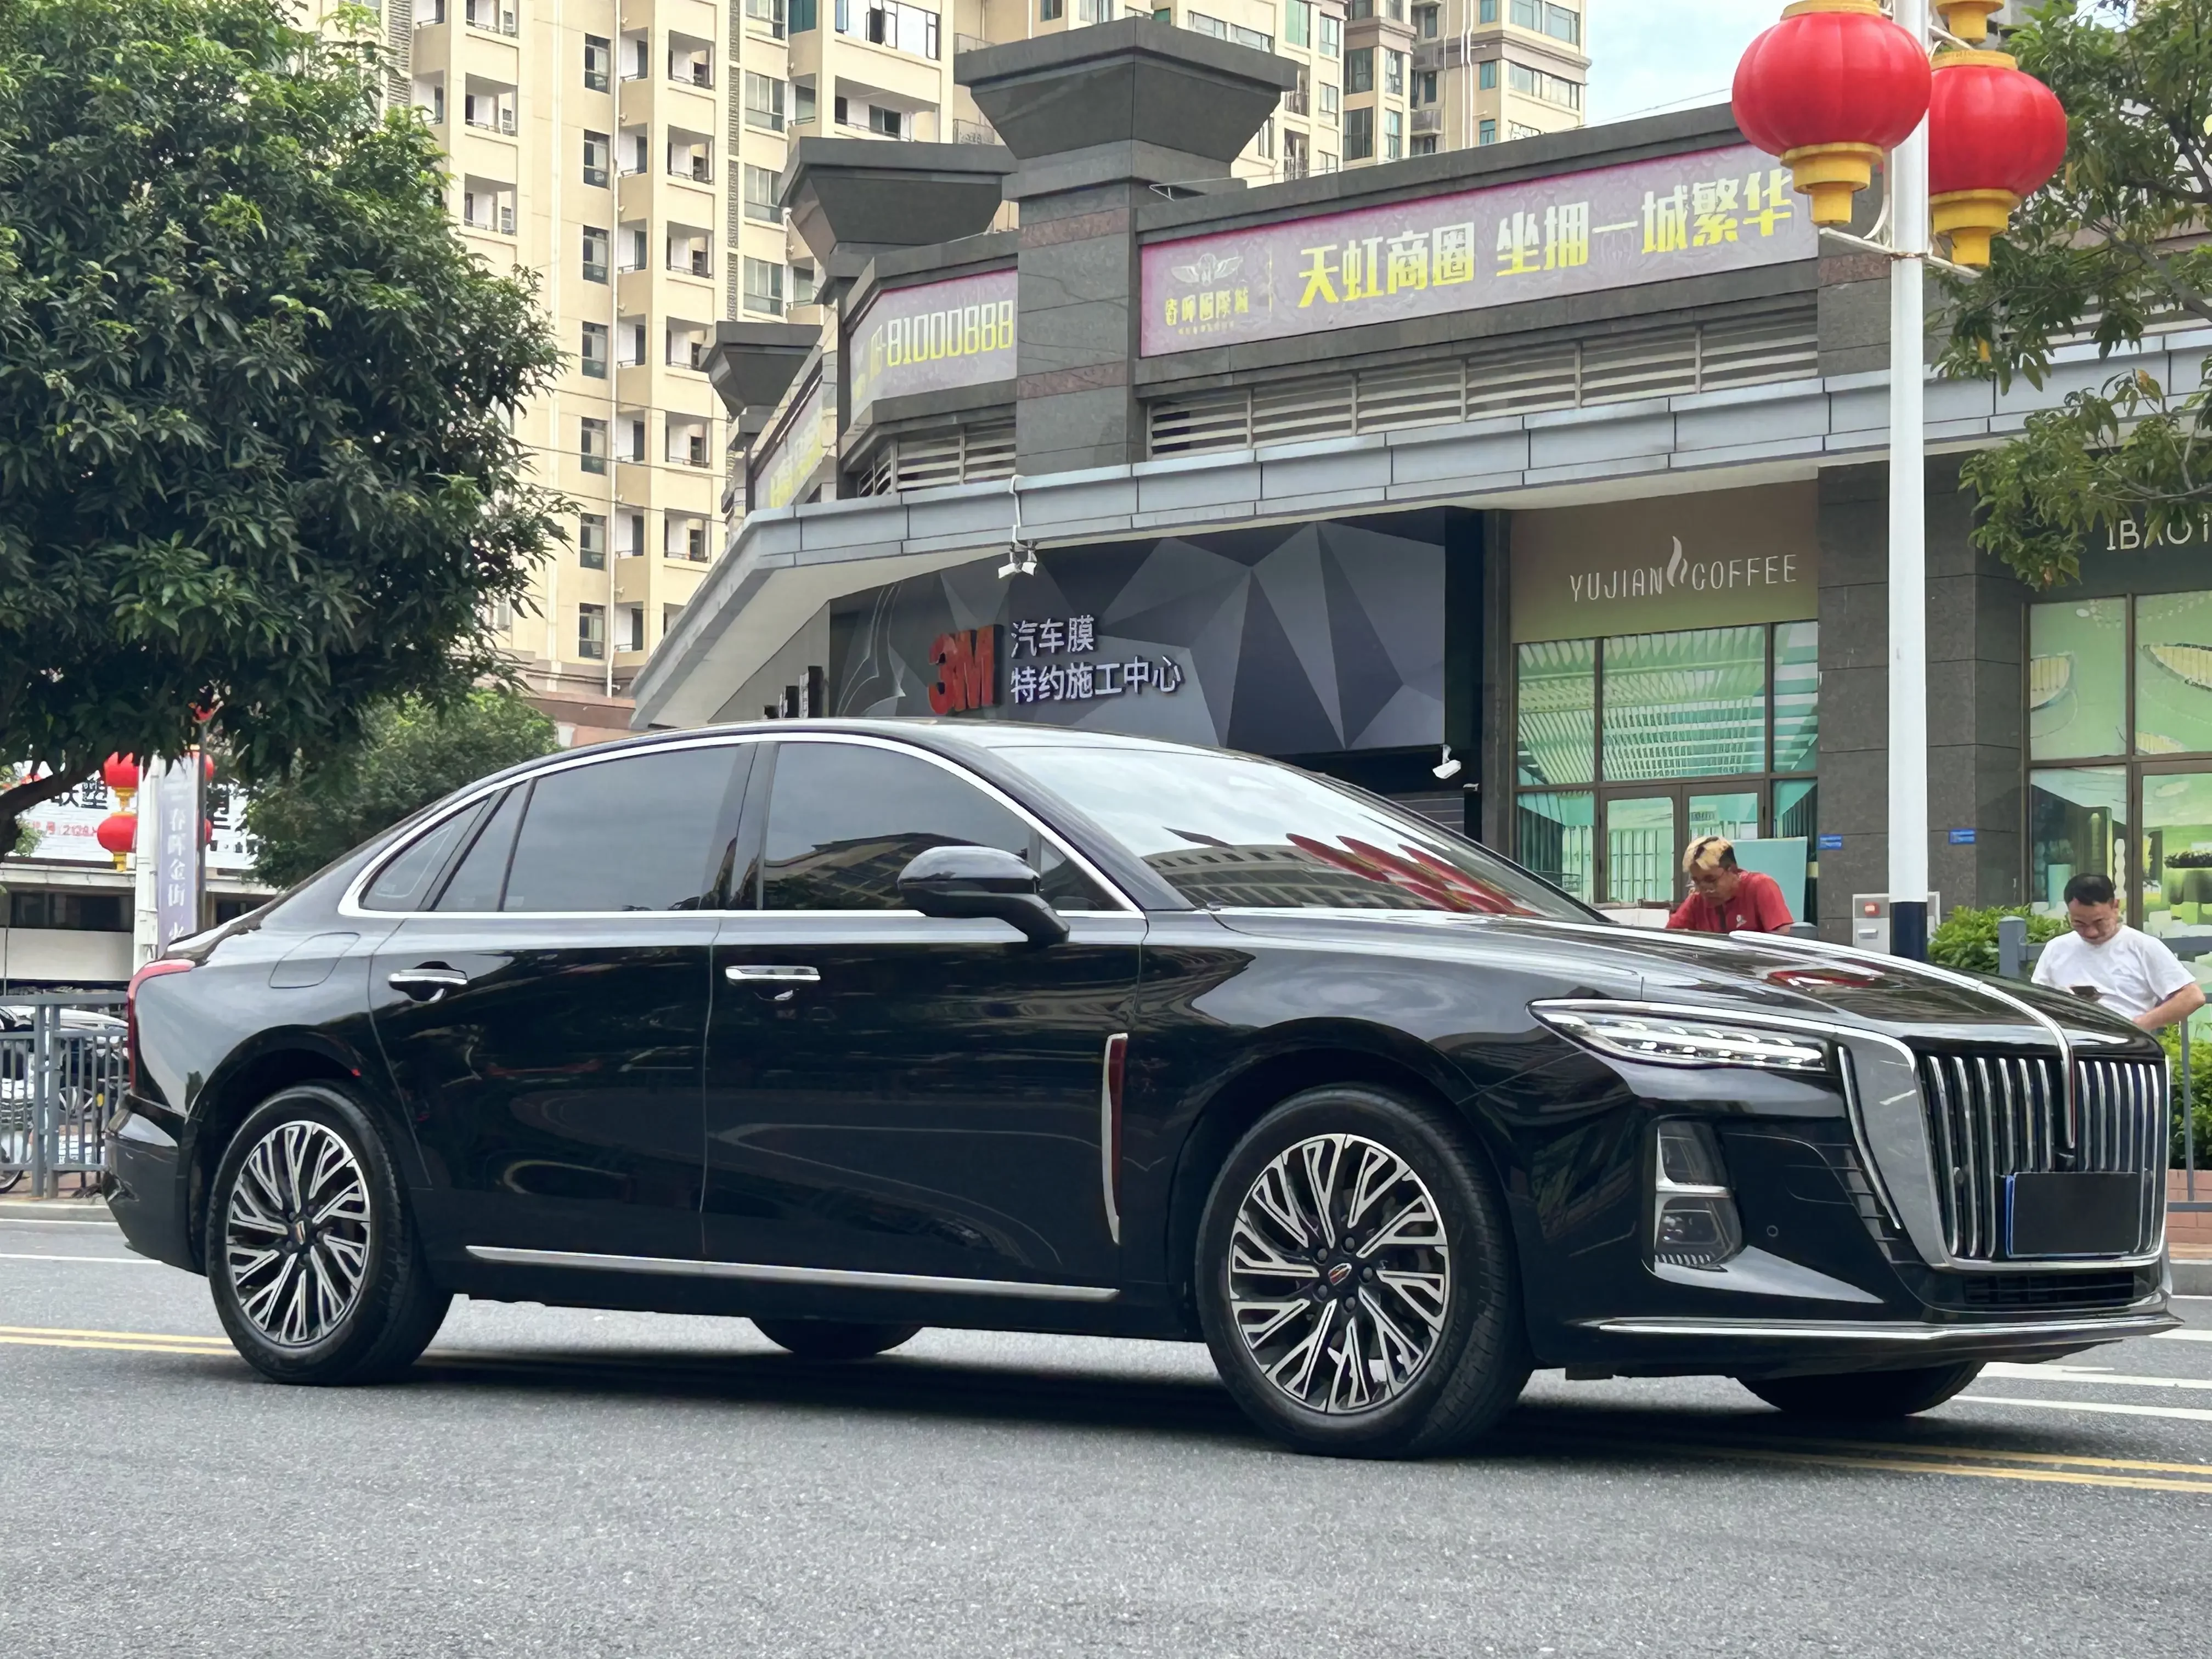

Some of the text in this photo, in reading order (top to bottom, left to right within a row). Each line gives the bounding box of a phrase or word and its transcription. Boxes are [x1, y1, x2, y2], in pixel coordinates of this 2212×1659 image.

[1297, 168, 1792, 308] 天虹商圈 坐拥一城繁华
[1570, 554, 1797, 602] YUJIAN COFFEE
[1010, 614, 1095, 658] 汽车膜
[928, 624, 995, 715] 3M
[1010, 655, 1182, 704] 特约施工中心
